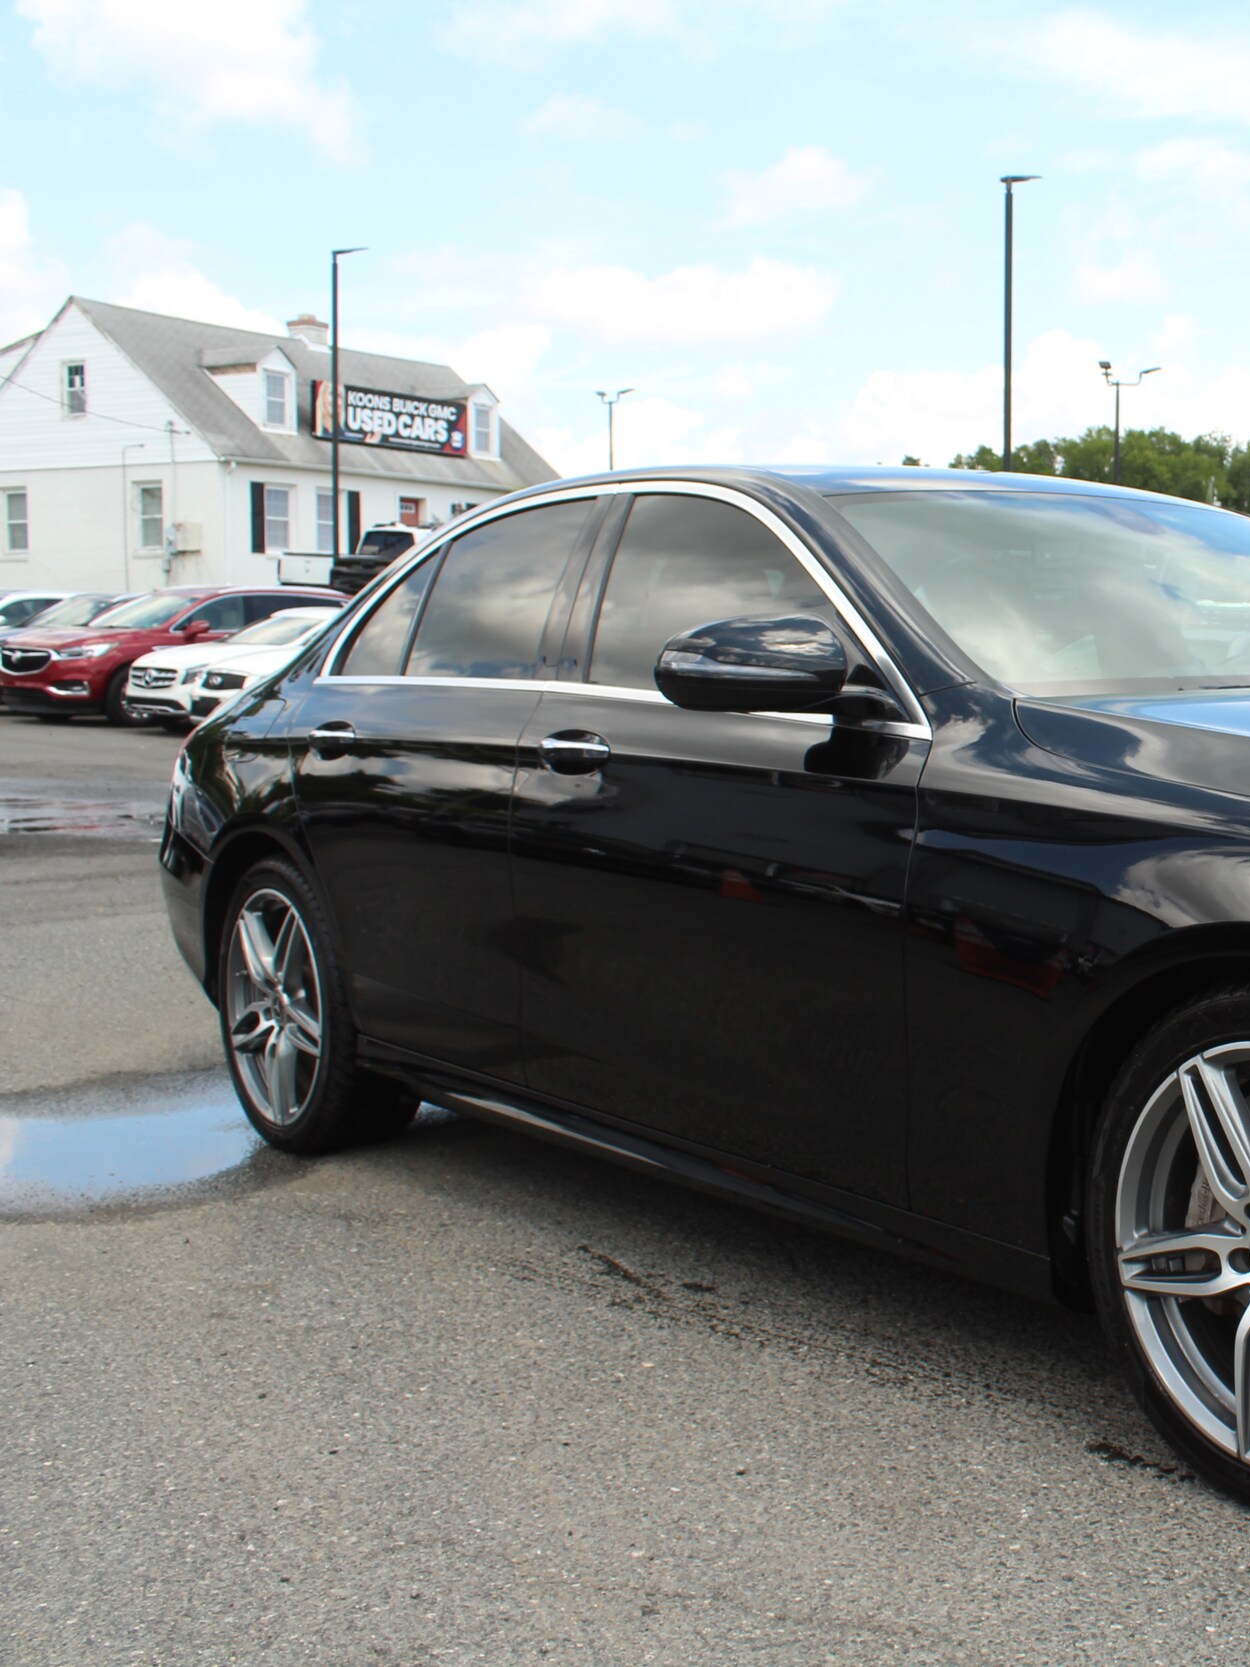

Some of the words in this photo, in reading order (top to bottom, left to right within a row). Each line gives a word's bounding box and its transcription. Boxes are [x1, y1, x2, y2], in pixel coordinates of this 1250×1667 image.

[347, 390, 391, 411] KOONS
[392, 397, 429, 417] BUICK
[428, 403, 458, 421] GMC
[347, 405, 397, 435] USED
[397, 414, 449, 443] CARS
